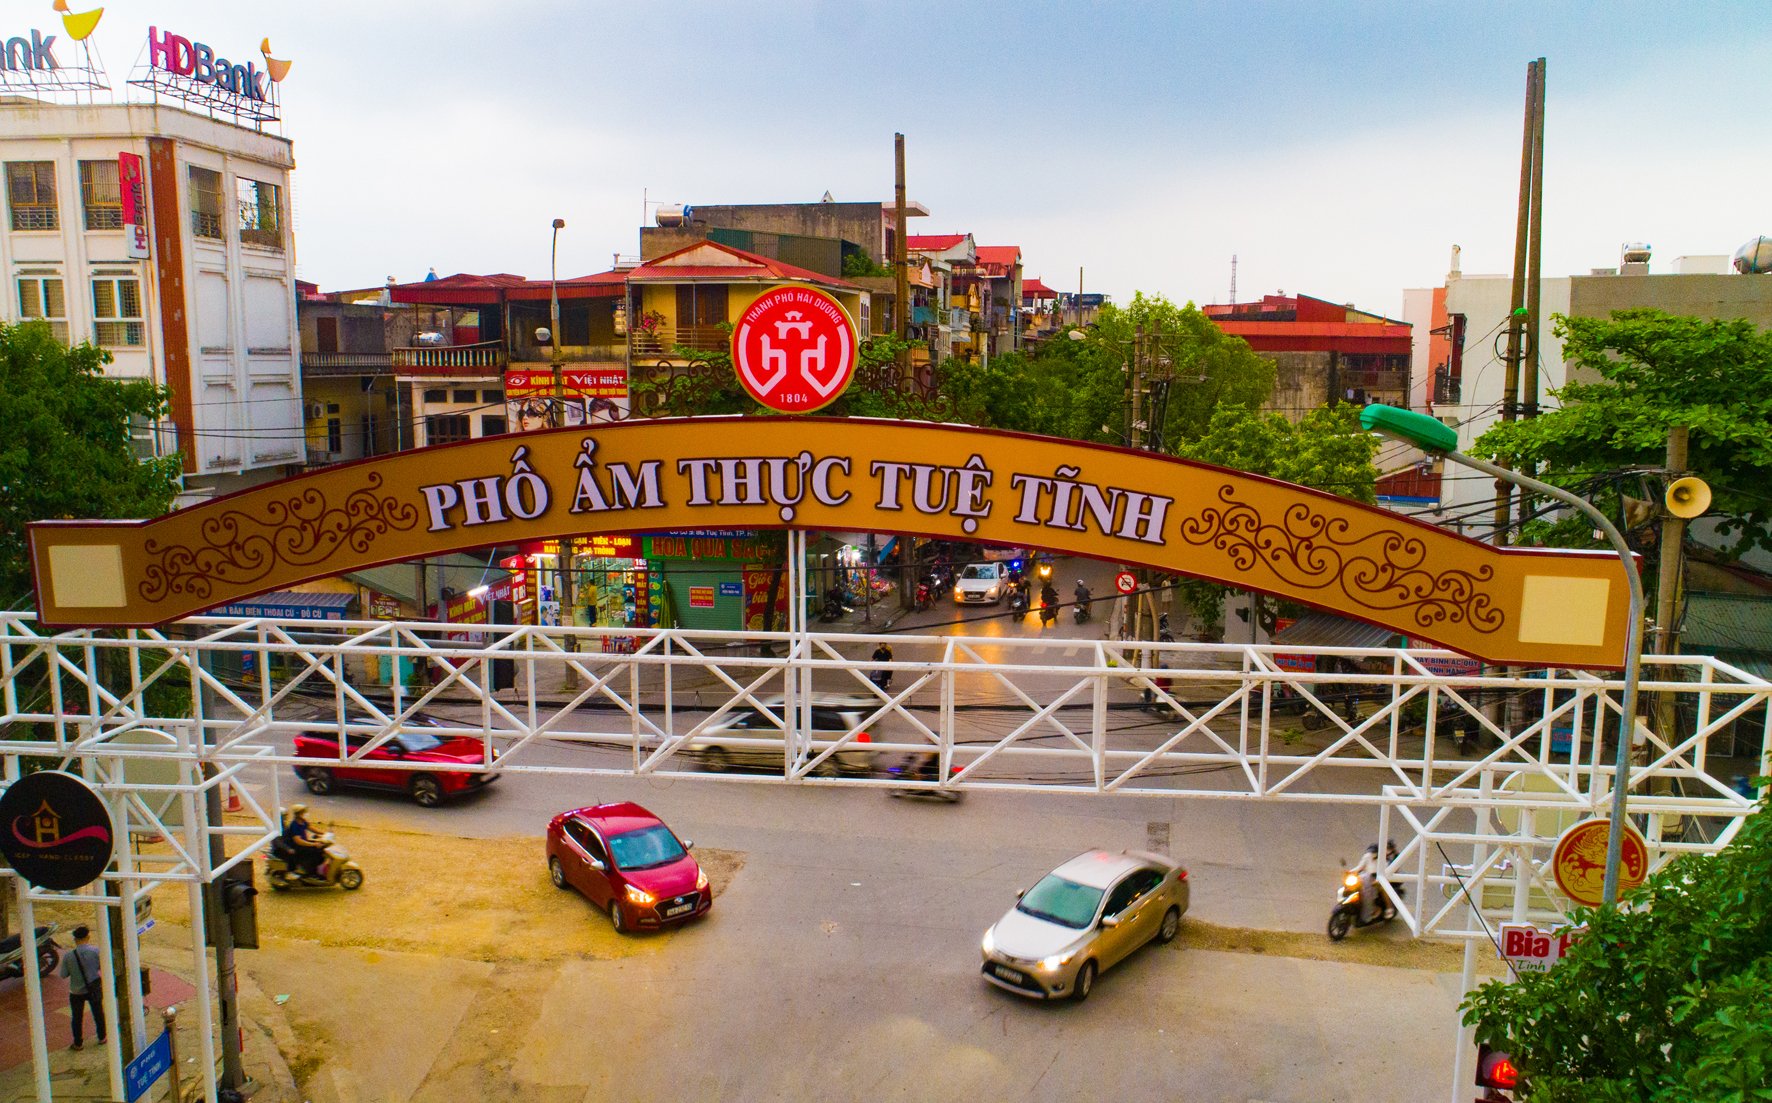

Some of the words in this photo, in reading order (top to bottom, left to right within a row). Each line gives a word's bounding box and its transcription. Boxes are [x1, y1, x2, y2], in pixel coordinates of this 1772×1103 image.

[149, 25, 266, 101] HDBank
[131, 182, 146, 250] HDBank
[780, 393, 808, 404] 1804
[418, 445, 551, 532] PHỐ
[569, 437, 666, 513] ẨM
[677, 449, 852, 522] THỰC
[871, 454, 993, 534] TUỆ
[1011, 464, 1175, 546] TĨNH
[1506, 930, 1550, 957] Bia
